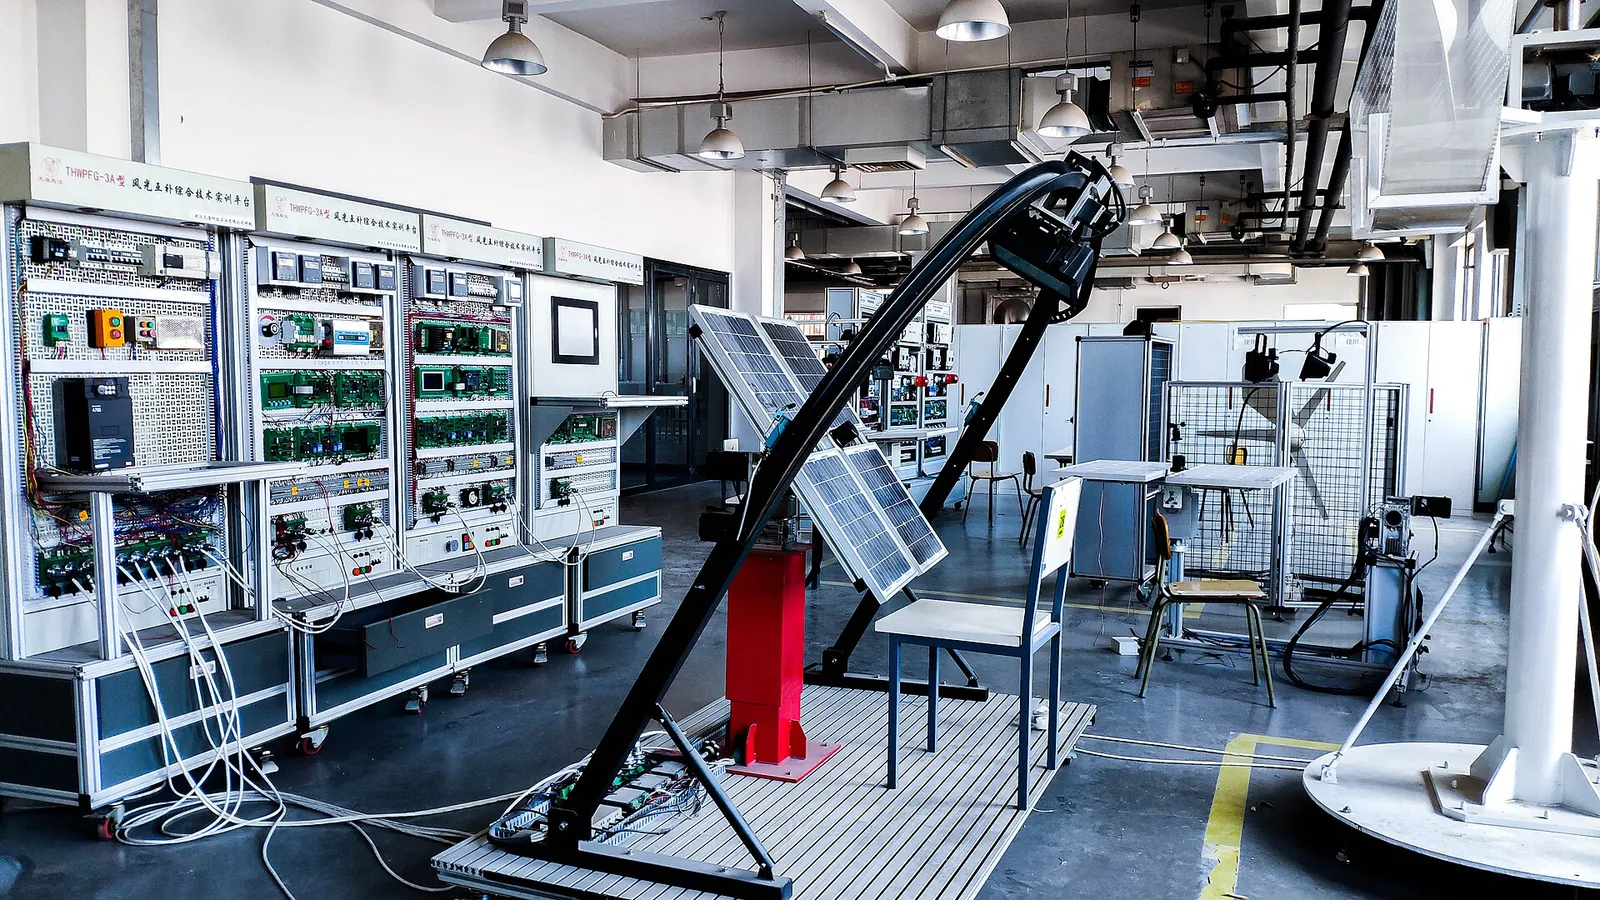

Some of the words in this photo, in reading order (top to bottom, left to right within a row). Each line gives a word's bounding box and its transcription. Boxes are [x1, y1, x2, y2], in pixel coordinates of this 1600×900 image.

[65, 166, 126, 187] THWPFG-3A型
[131, 177, 250, 207] 风光互补综合技术实训平台
[289, 202, 331, 219] THWPFG-3A型
[333, 211, 417, 235] 风光互补综合技术实训平台
